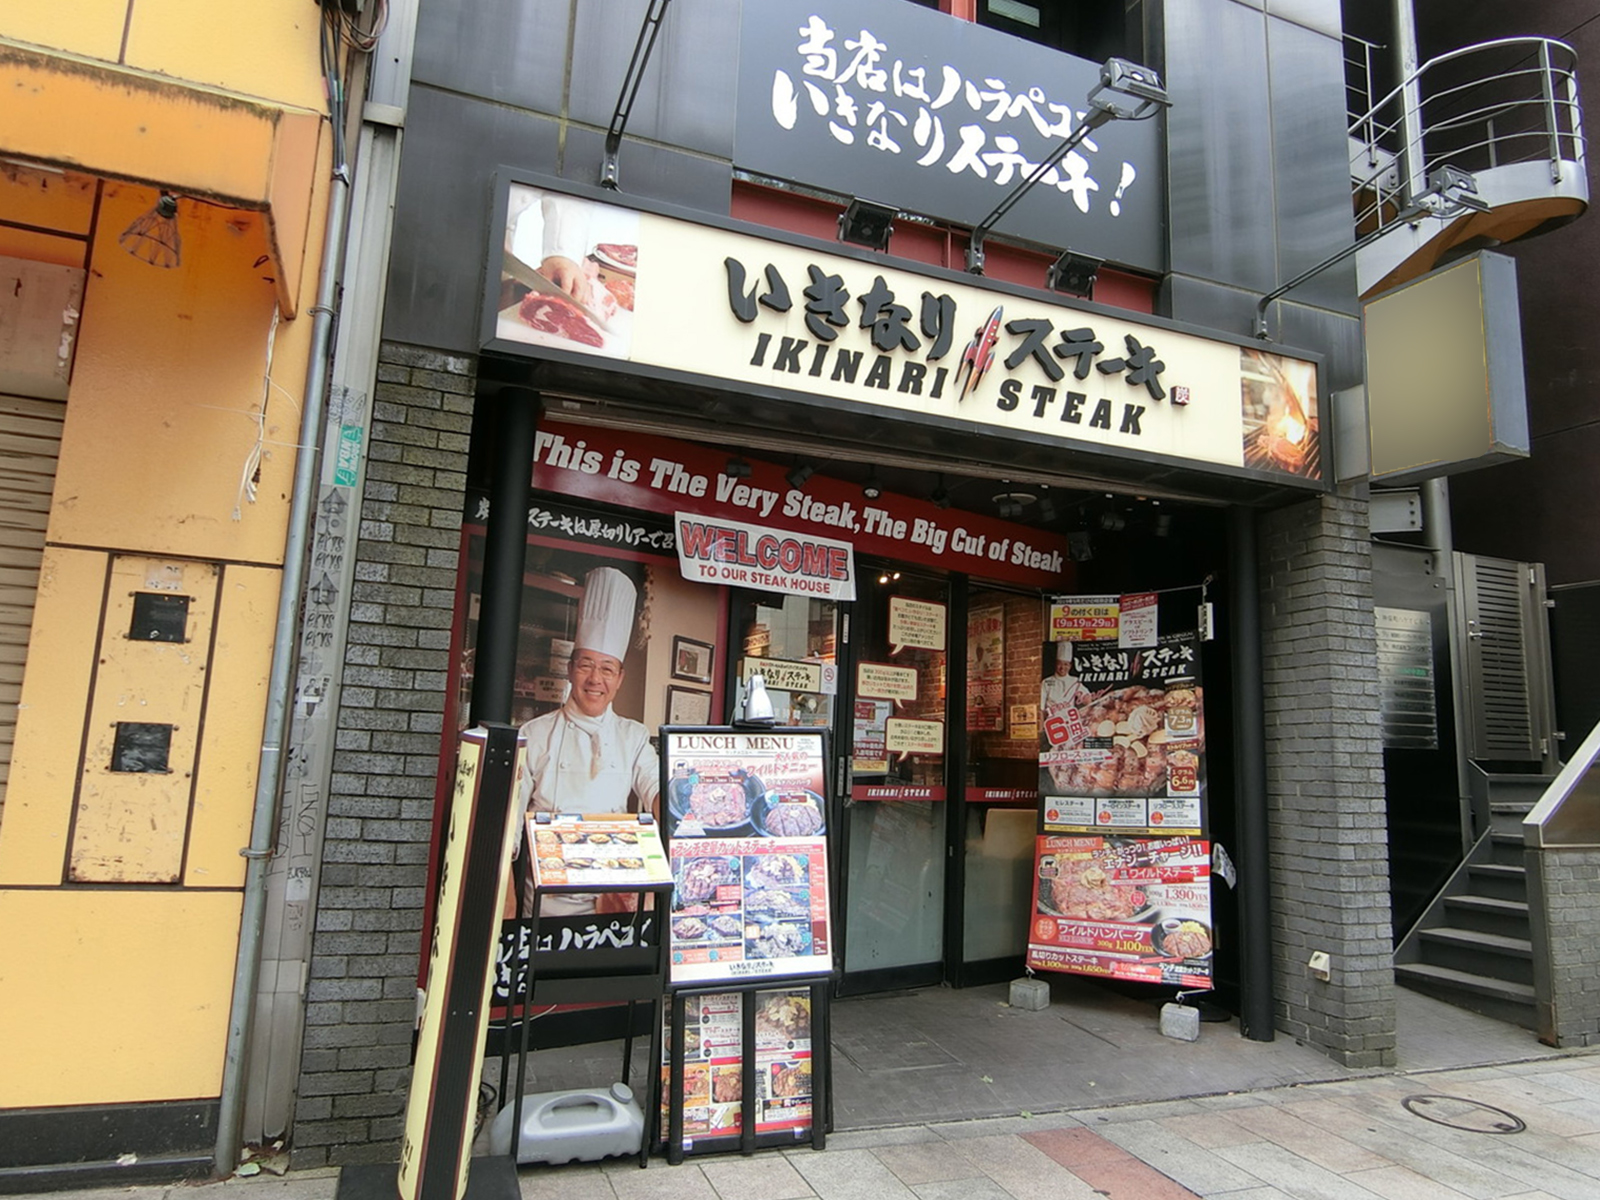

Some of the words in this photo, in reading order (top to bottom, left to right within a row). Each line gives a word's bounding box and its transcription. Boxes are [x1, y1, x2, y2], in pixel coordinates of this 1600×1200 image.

[724, 257, 957, 361] いきなり
[1004, 317, 1166, 401] ステーキ
[750, 333, 948, 399] IKINARI
[997, 378, 1146, 436] STEAK
[533, 430, 603, 475] This
[607, 449, 641, 483] is
[649, 458, 708, 498] The
[715, 472, 779, 518] Very
[783, 489, 861, 534] Steak,
[862, 506, 907, 543] The
[910, 518, 952, 555] Big
[950, 527, 986, 555] Cut
[987, 538, 1009, 561] of
[1010, 540, 1064, 574] Steak
[679, 519, 850, 583] WELCOME
[698, 563, 717, 578] TO
[721, 566, 748, 583] OUR
[751, 570, 788, 589] STEAK
[790, 576, 831, 594] HOUSE
[1073, 651, 1128, 672] いきなり
[1141, 645, 1194, 667] ステーキ
[1078, 671, 1129, 682] IKINARI
[1142, 664, 1186, 679] STEAK
[677, 735, 736, 749] LUNCH
[746, 736, 794, 750] MENU
[867, 788, 898, 797] IKINARI
[903, 788, 931, 797] STEAK
[1046, 839, 1074, 848] LUNCH
[1074, 838, 1096, 847] MENU
[1059, 925, 1144, 941] ワイルドハンバーグ
